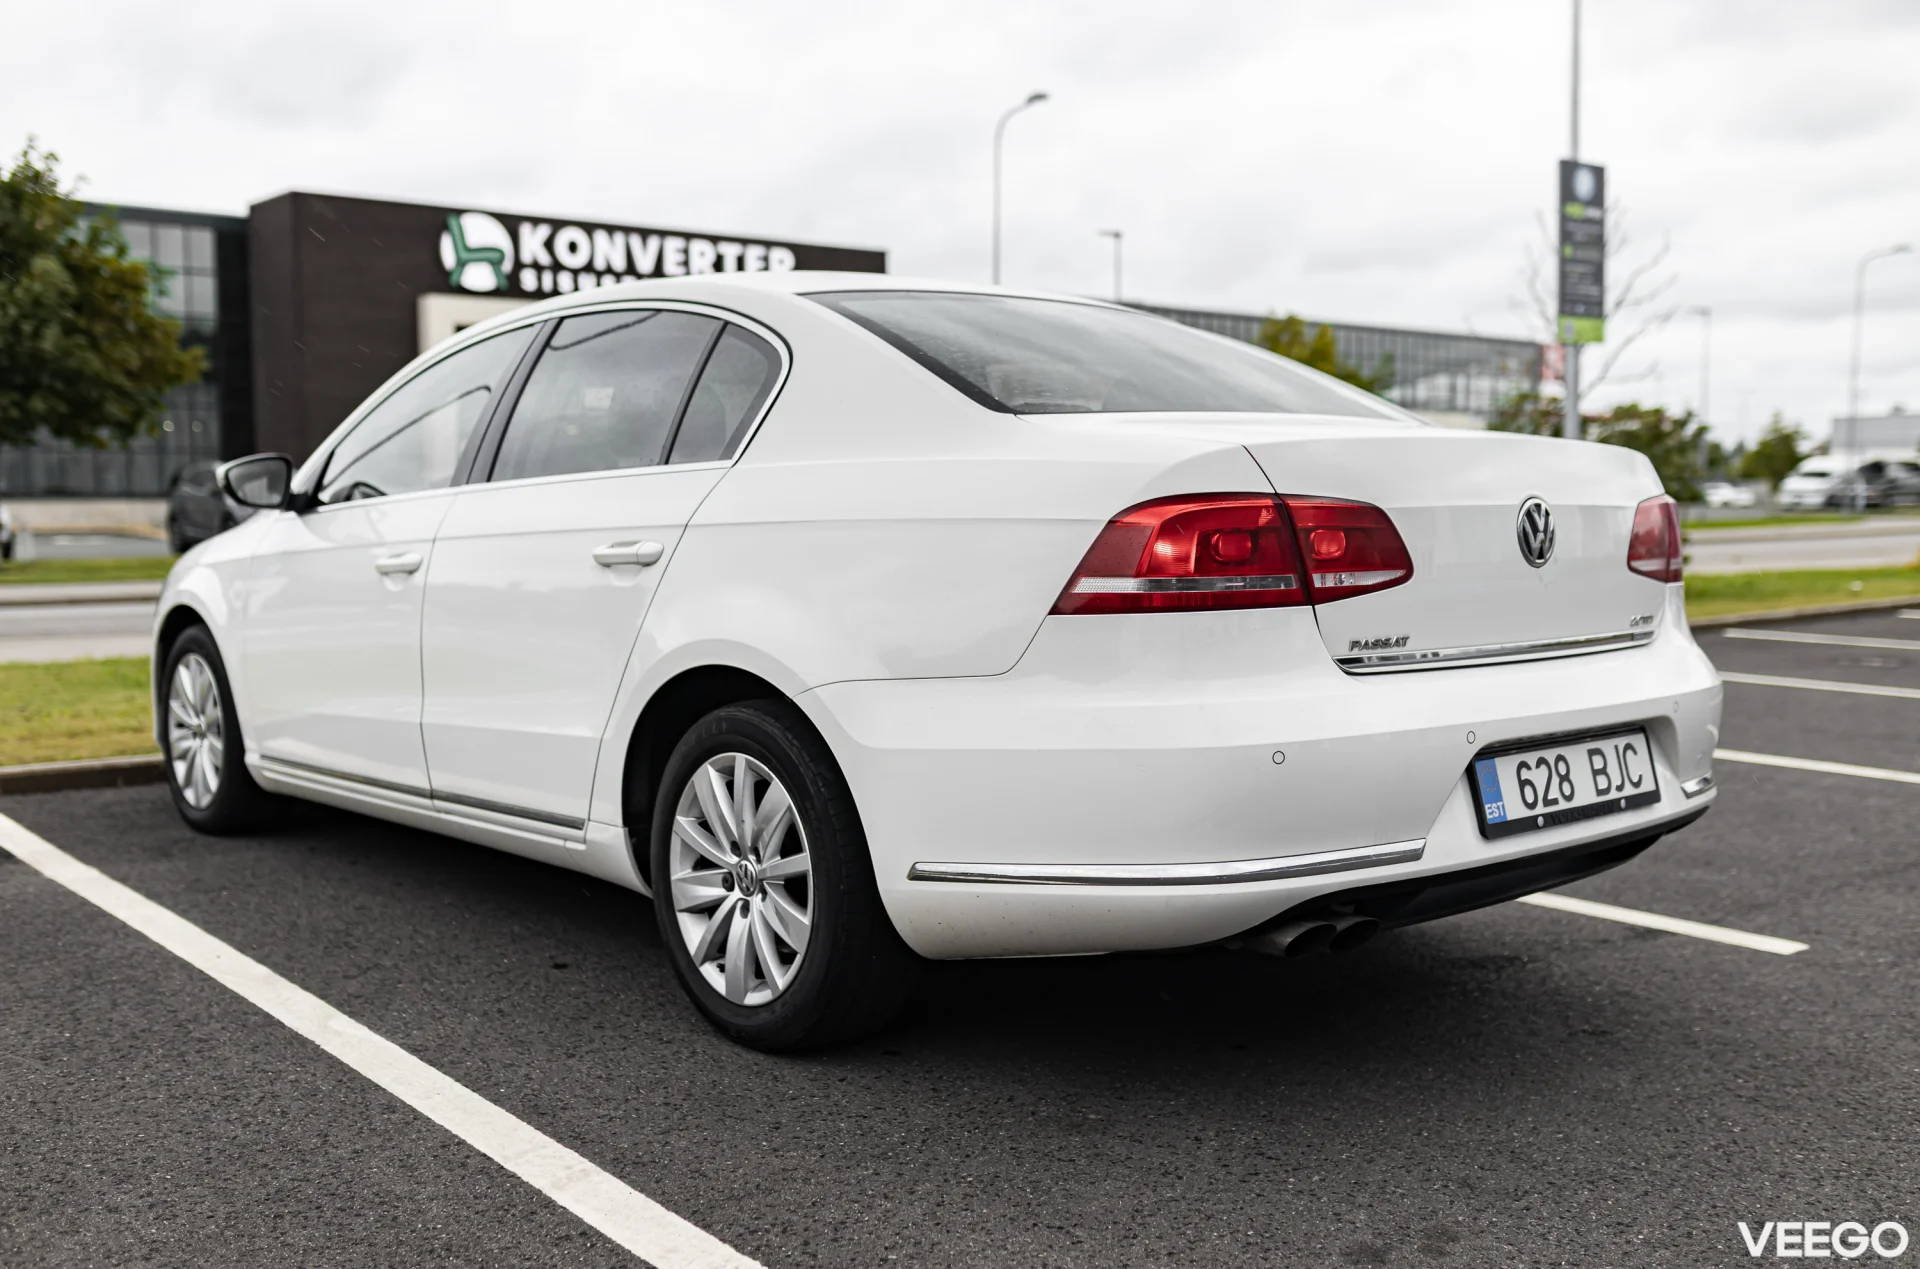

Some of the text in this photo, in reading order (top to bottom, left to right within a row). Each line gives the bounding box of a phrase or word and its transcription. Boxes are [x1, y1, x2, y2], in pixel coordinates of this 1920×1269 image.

[518, 221, 797, 275] KONVERTER
[1348, 635, 1410, 652] PASSAT
[1516, 742, 1643, 810] 628 BJC
[1485, 801, 1505, 819] EST
